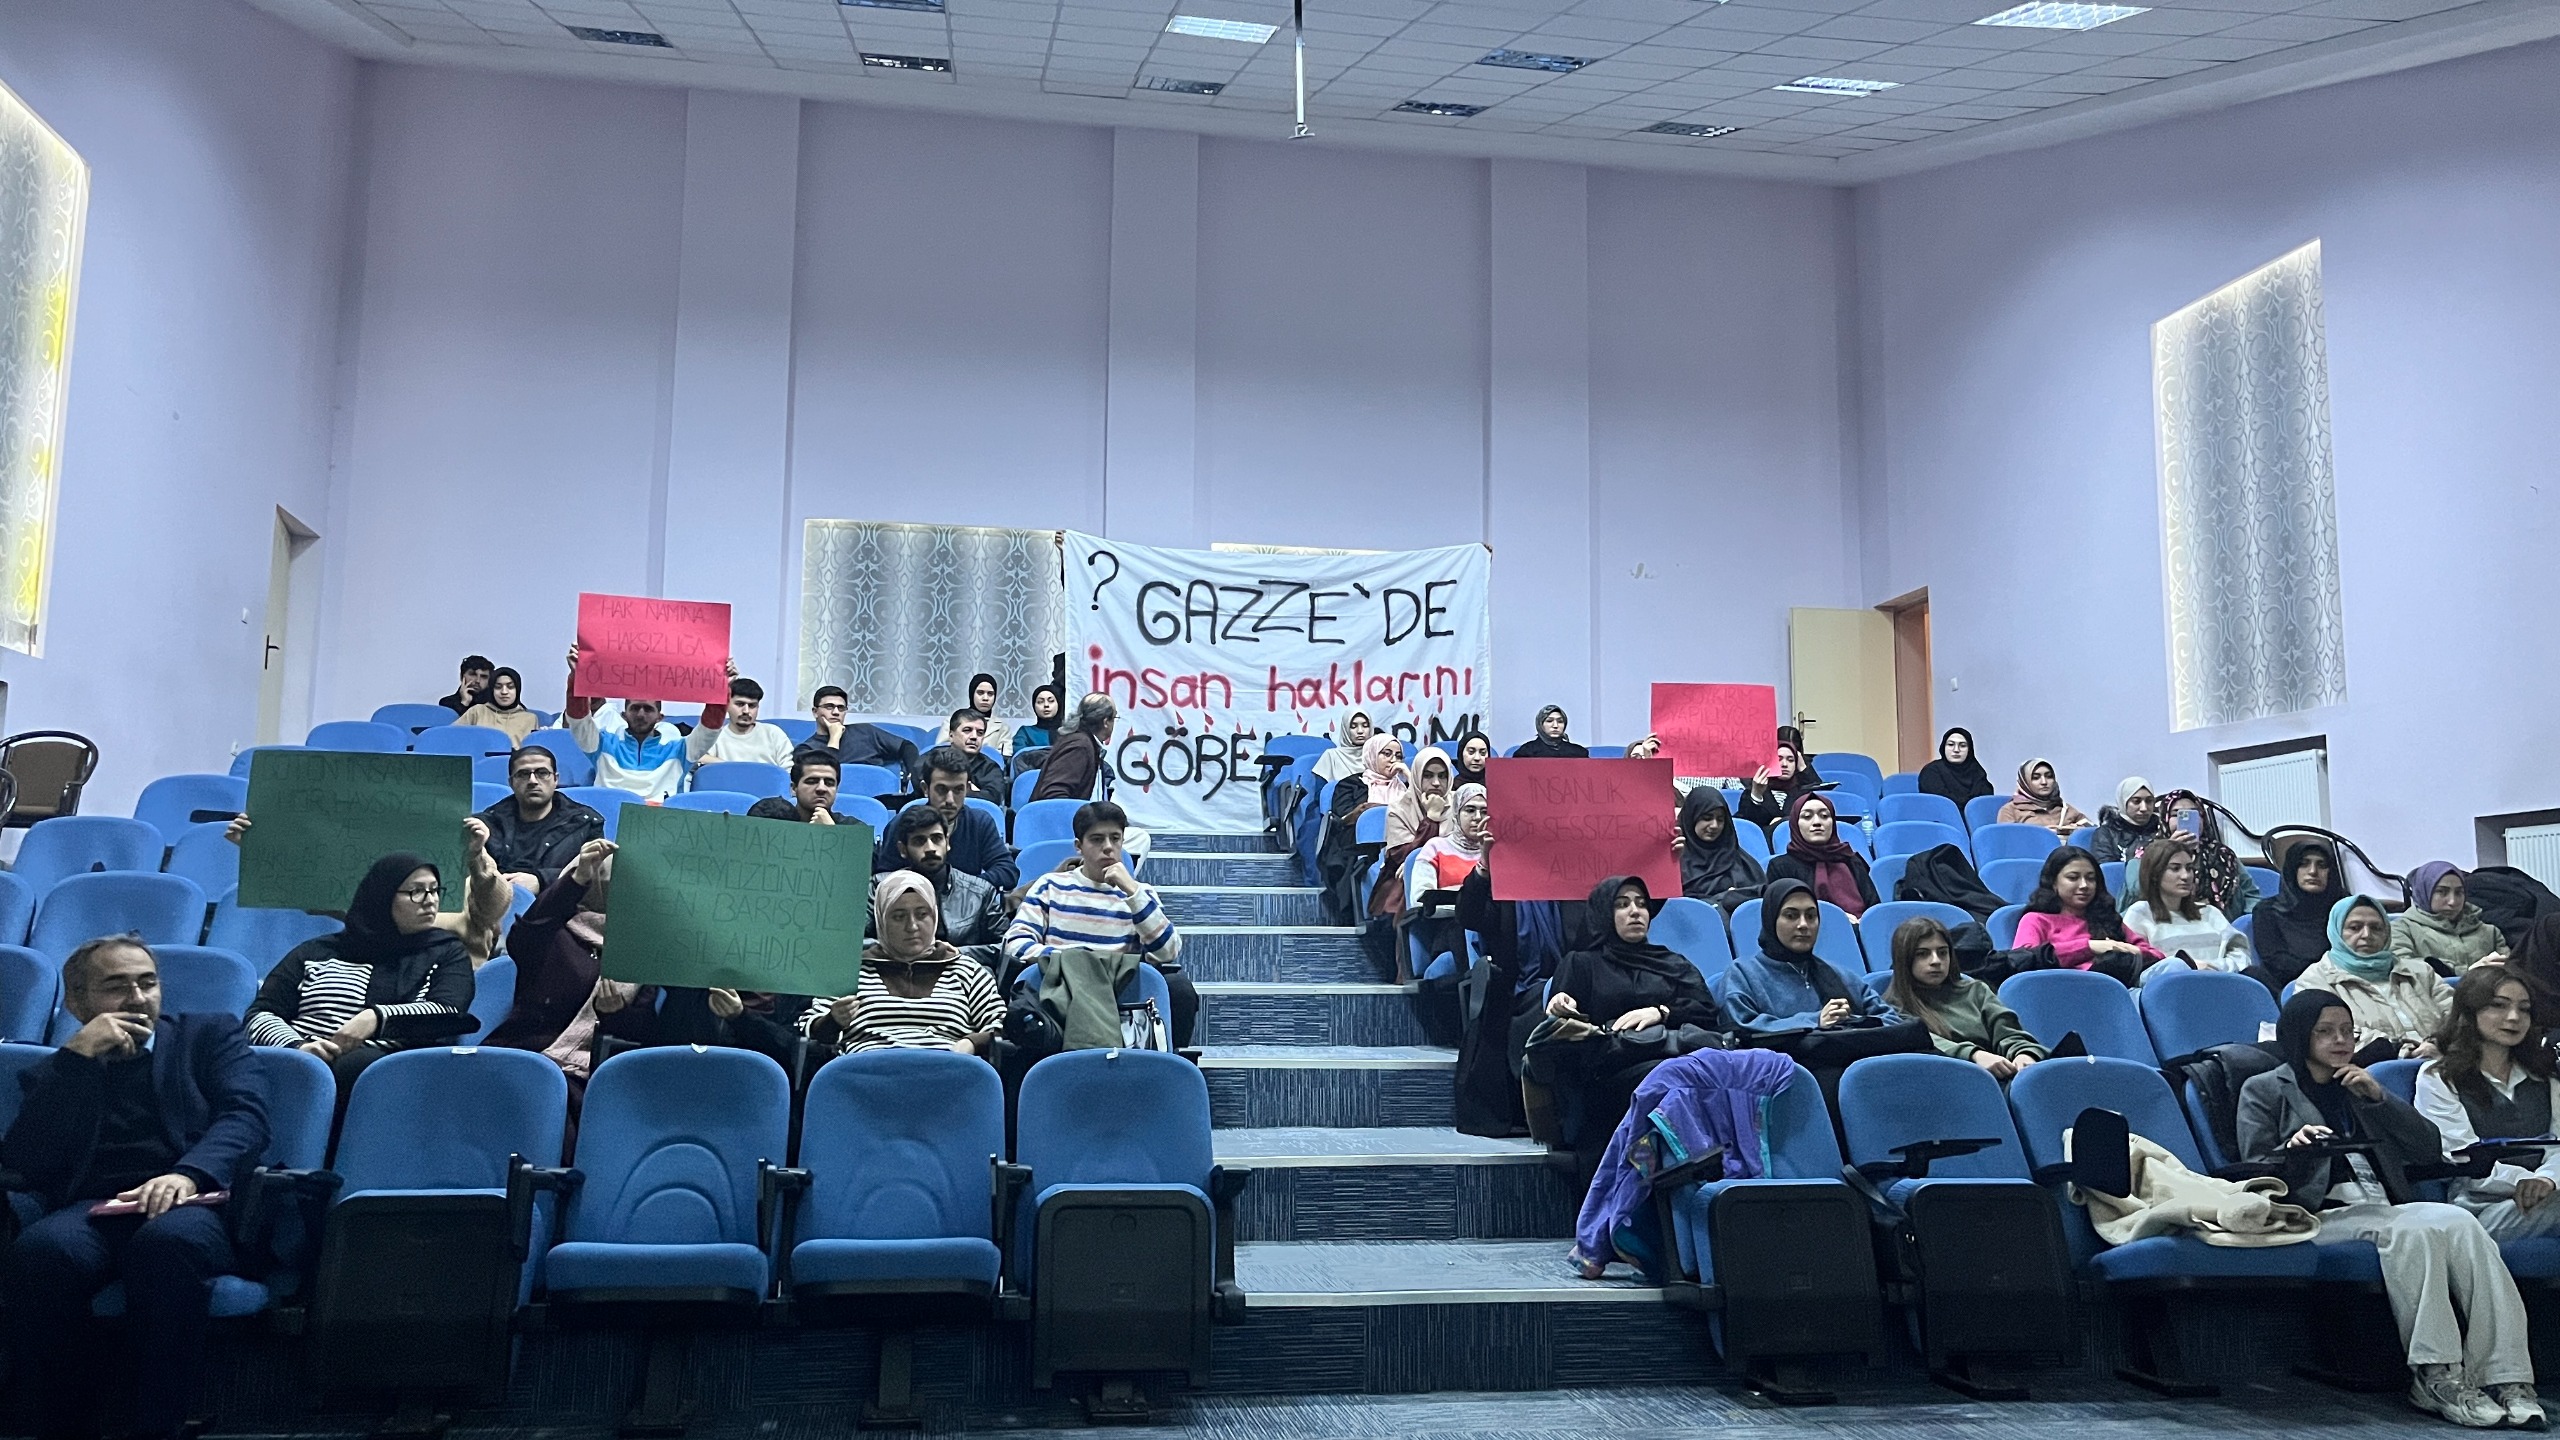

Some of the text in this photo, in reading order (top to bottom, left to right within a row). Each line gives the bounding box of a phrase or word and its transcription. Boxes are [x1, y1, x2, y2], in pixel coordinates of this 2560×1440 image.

[1087, 550, 1120, 611] ?
[601, 598, 706, 624] HAK NAMINA
[607, 630, 707, 657] HAKSIZLIĞA
[586, 660, 726, 690] ÖLSEM TAPAMAM
[1267, 659, 1473, 712] haklarını
[724, 822, 847, 862] HAKLARI
